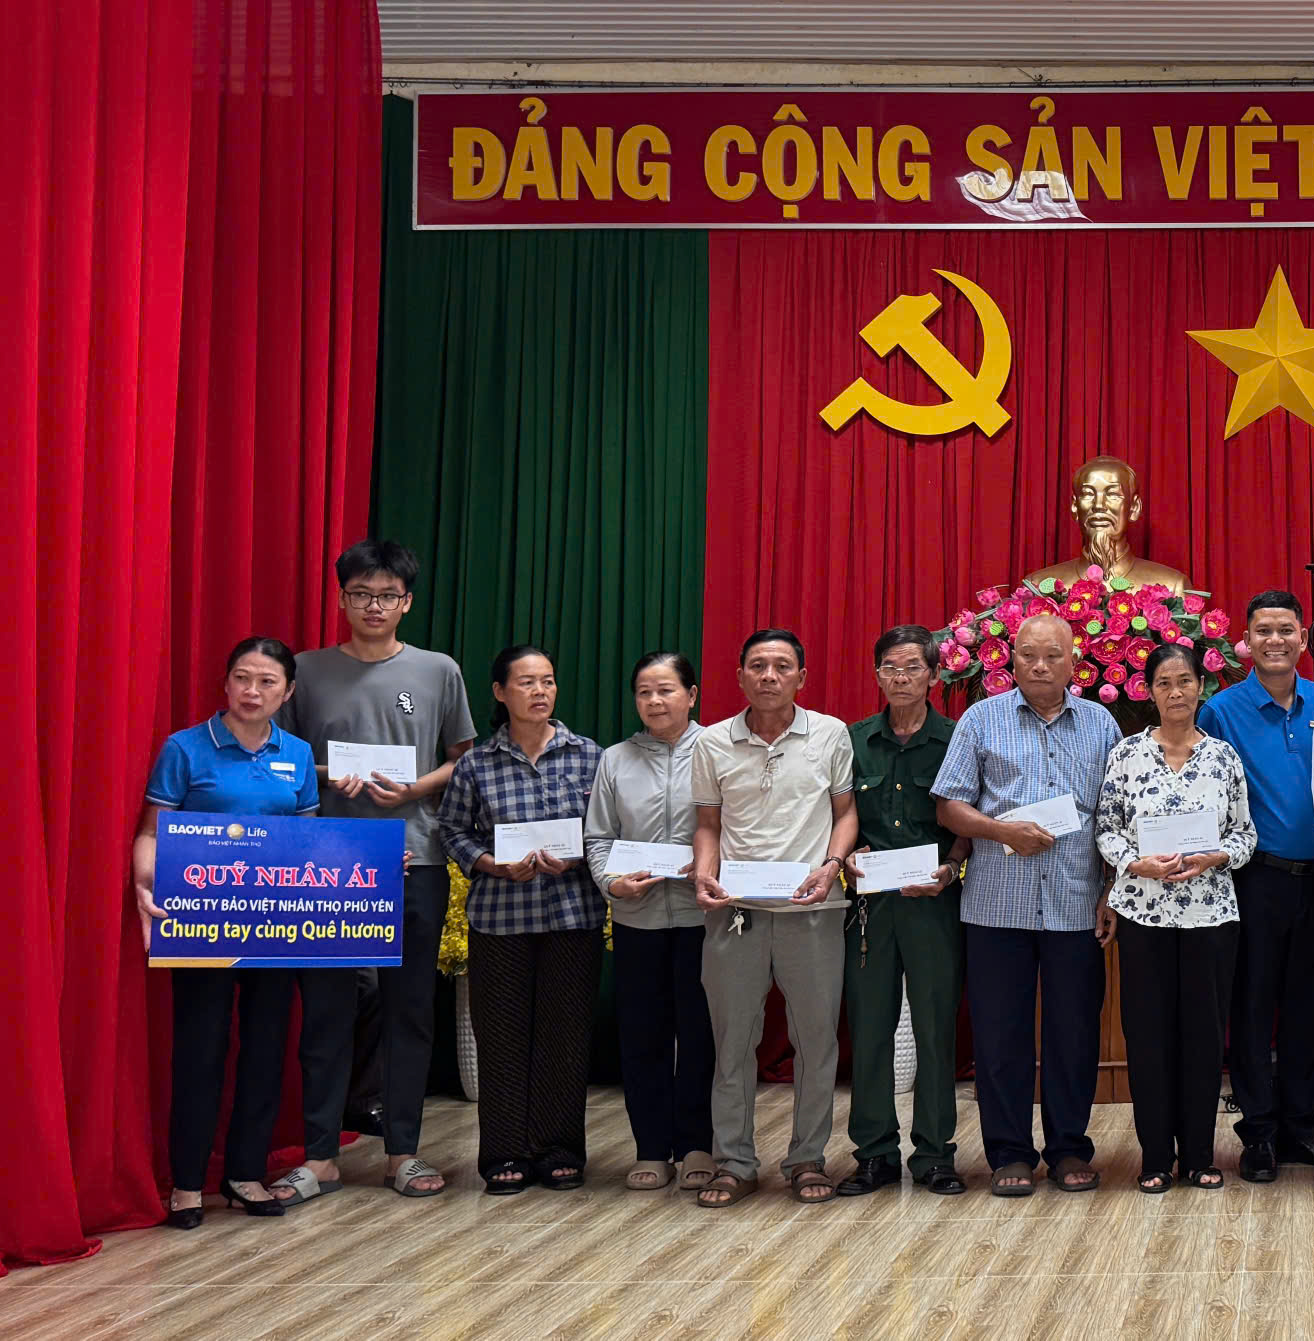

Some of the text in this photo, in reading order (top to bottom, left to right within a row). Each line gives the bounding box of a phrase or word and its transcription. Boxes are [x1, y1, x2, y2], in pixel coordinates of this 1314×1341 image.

[449, 97, 671, 201] ĐẢNG
[704, 103, 931, 218] CỘNG
[965, 96, 1122, 201] SẢN
[168, 824, 268, 837] BAOVIET Life
[183, 860, 378, 889] QUỸ NHÂN ÁI
[164, 896, 394, 915] CÔNG TY BẢO VIỆT NHÂN THỌ PHÚ YÊN
[160, 918, 395, 943] Chung tay cùng Quê hương
